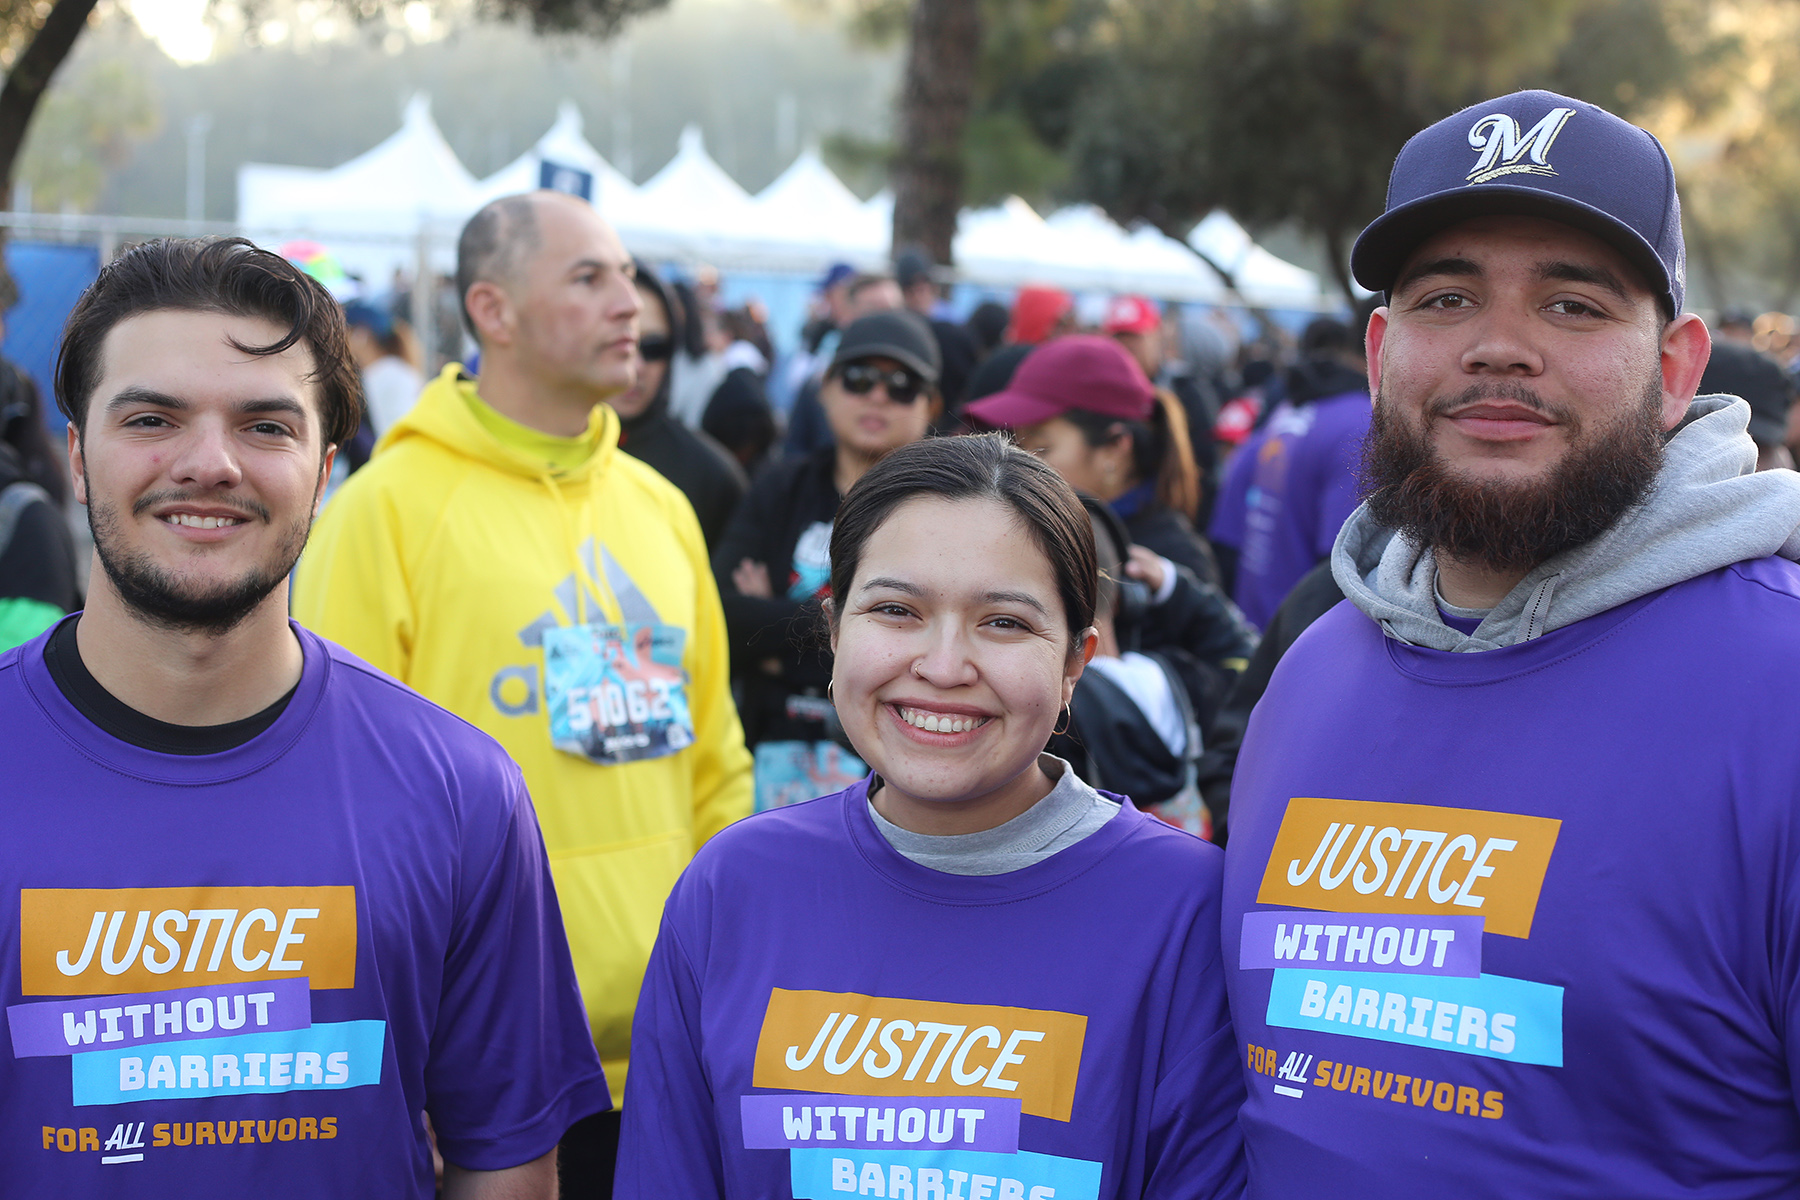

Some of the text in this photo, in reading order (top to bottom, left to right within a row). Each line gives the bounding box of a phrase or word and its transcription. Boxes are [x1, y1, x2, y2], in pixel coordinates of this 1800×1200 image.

[1287, 822, 1518, 909] JUSTICE
[56, 908, 319, 977] JUSTICE
[1274, 923, 1455, 968] WITHOUT
[62, 992, 276, 1046] WITHOUT
[1299, 979, 1517, 1055] BARRIERS
[119, 1051, 350, 1092] BARRIERS
[784, 1012, 1046, 1092] JUSTICE
[1247, 1043, 1505, 1121] FOR ALL SURVIVORS
[42, 1116, 338, 1153] FOR ALL SURVIVORS
[782, 1106, 986, 1143] WITHOUT
